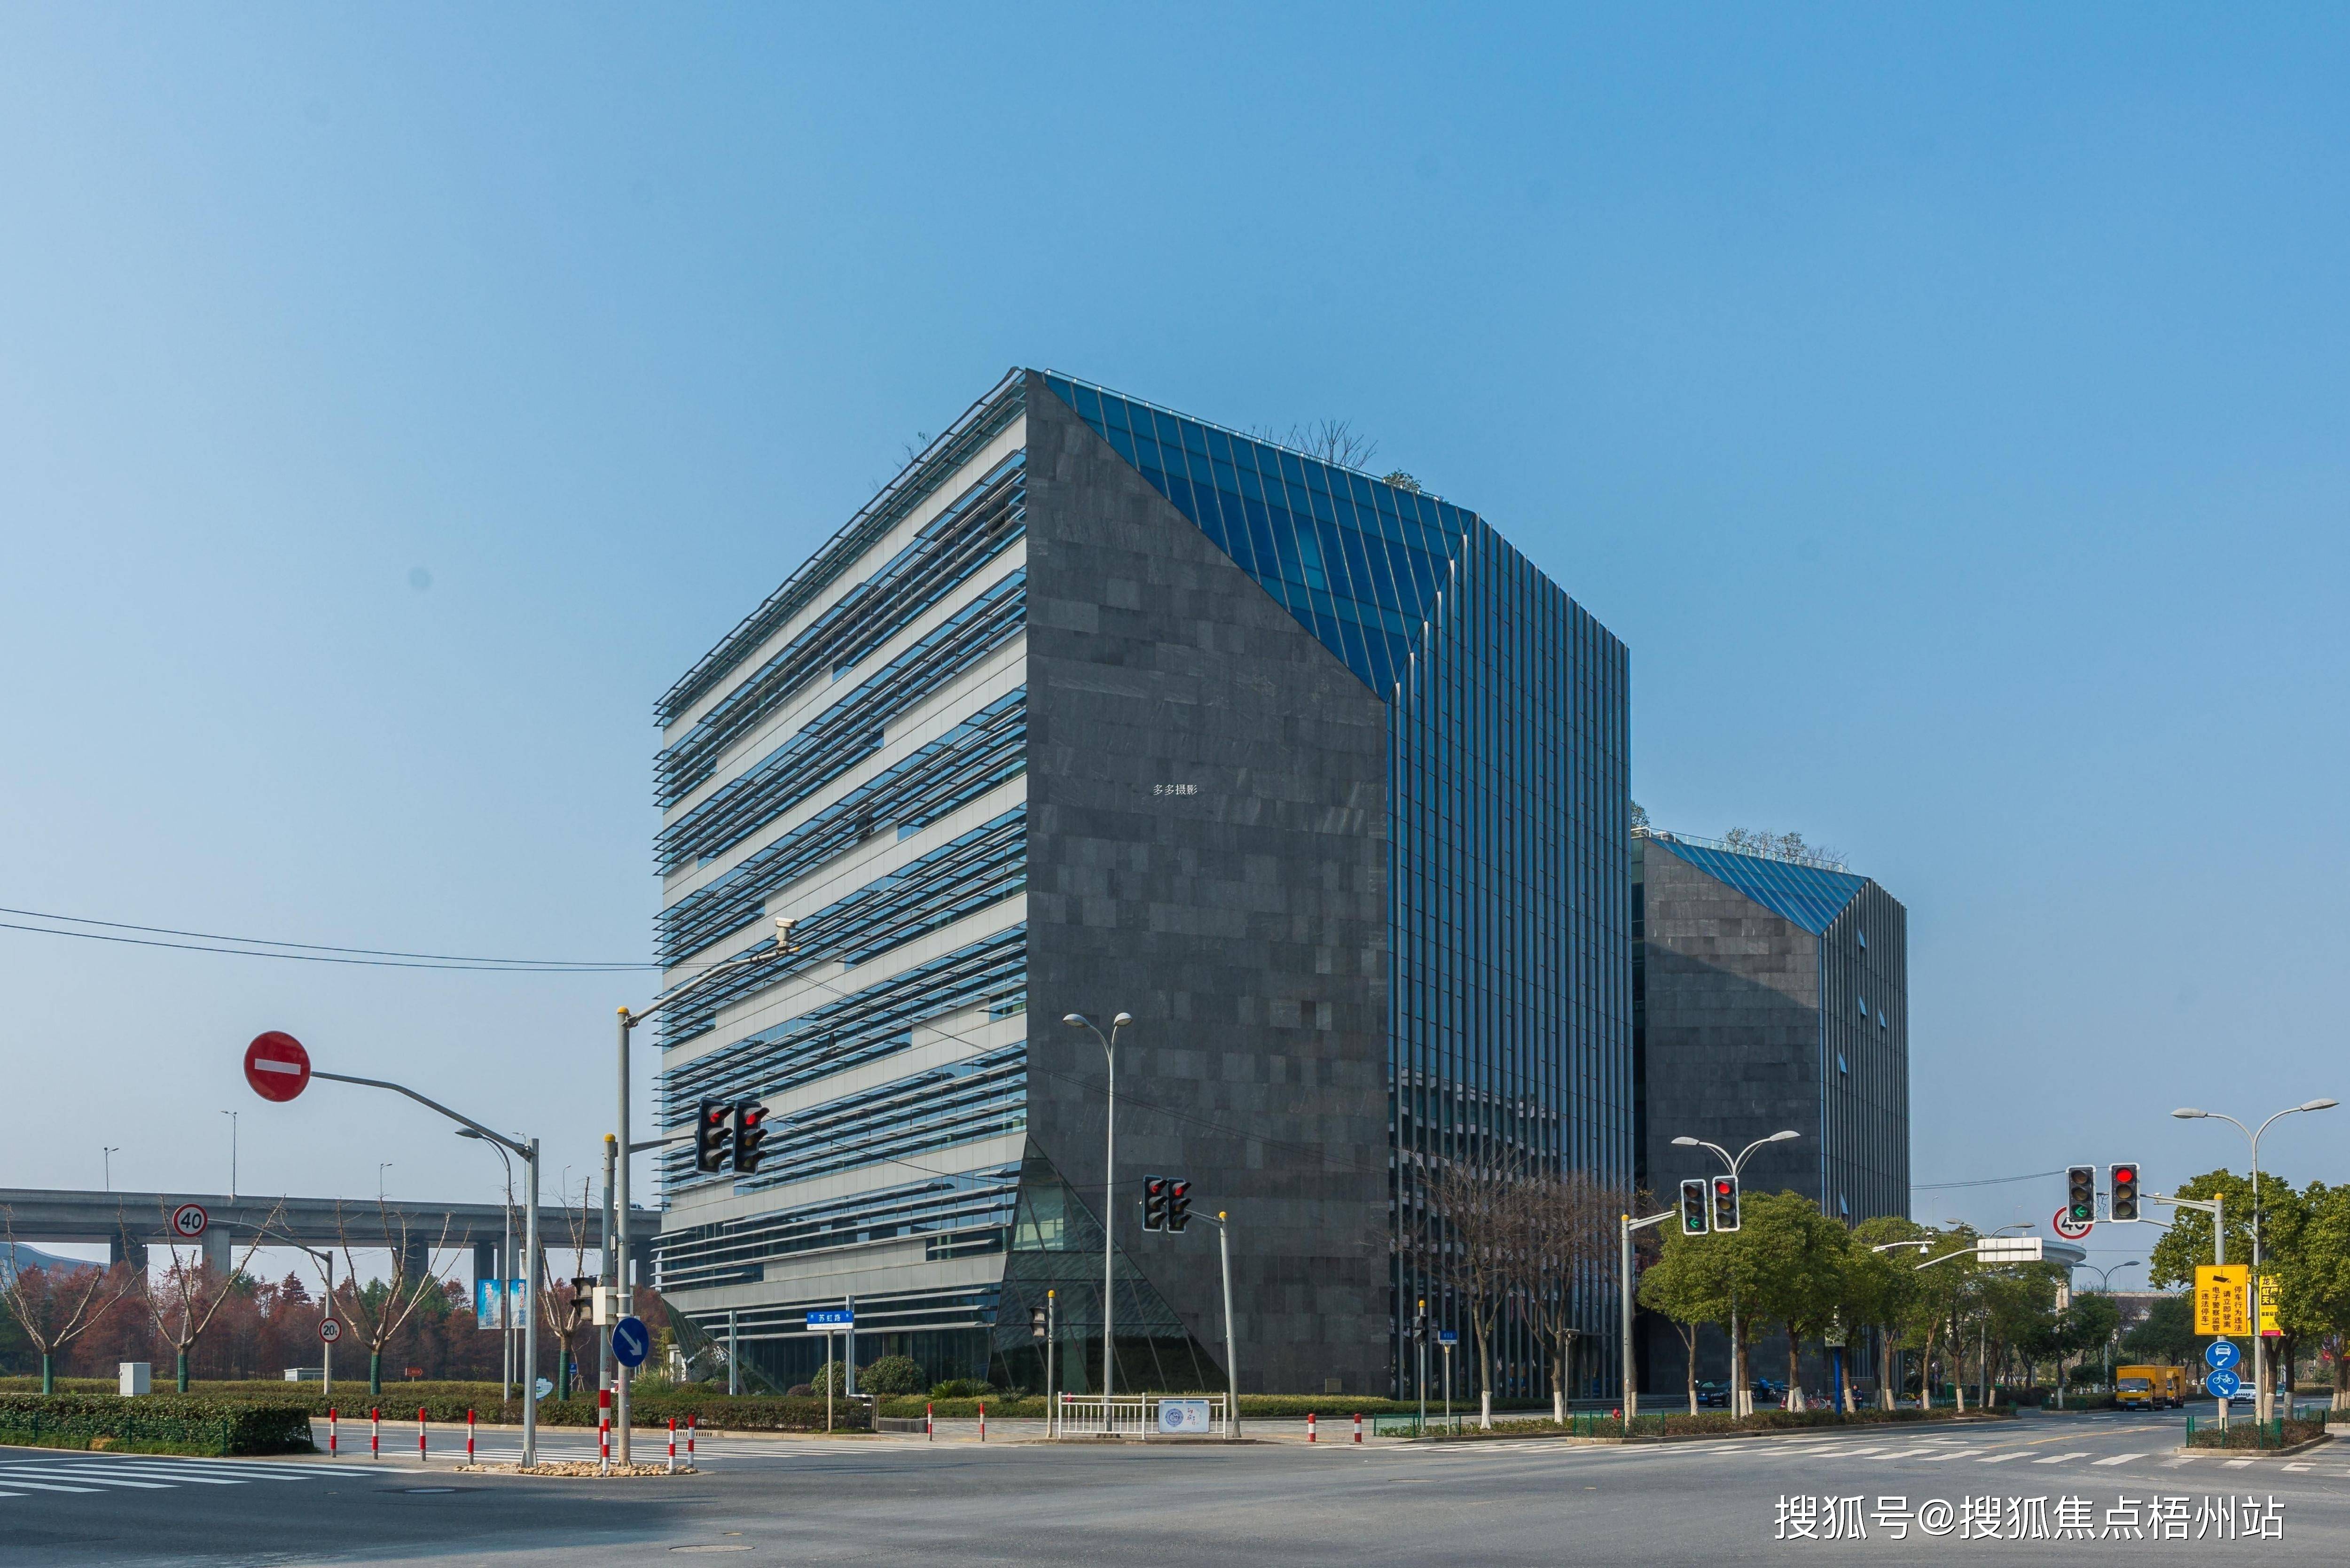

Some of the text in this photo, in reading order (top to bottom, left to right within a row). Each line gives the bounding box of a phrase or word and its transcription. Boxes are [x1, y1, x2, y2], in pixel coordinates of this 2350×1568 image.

[180, 1212, 202, 1229] 40
[2223, 1291, 2231, 1328] 请立即驶离
[2234, 1286, 2242, 1331] 停车行为违法
[819, 1314, 840, 1322] 苏虹路
[323, 1325, 337, 1335] 20t
